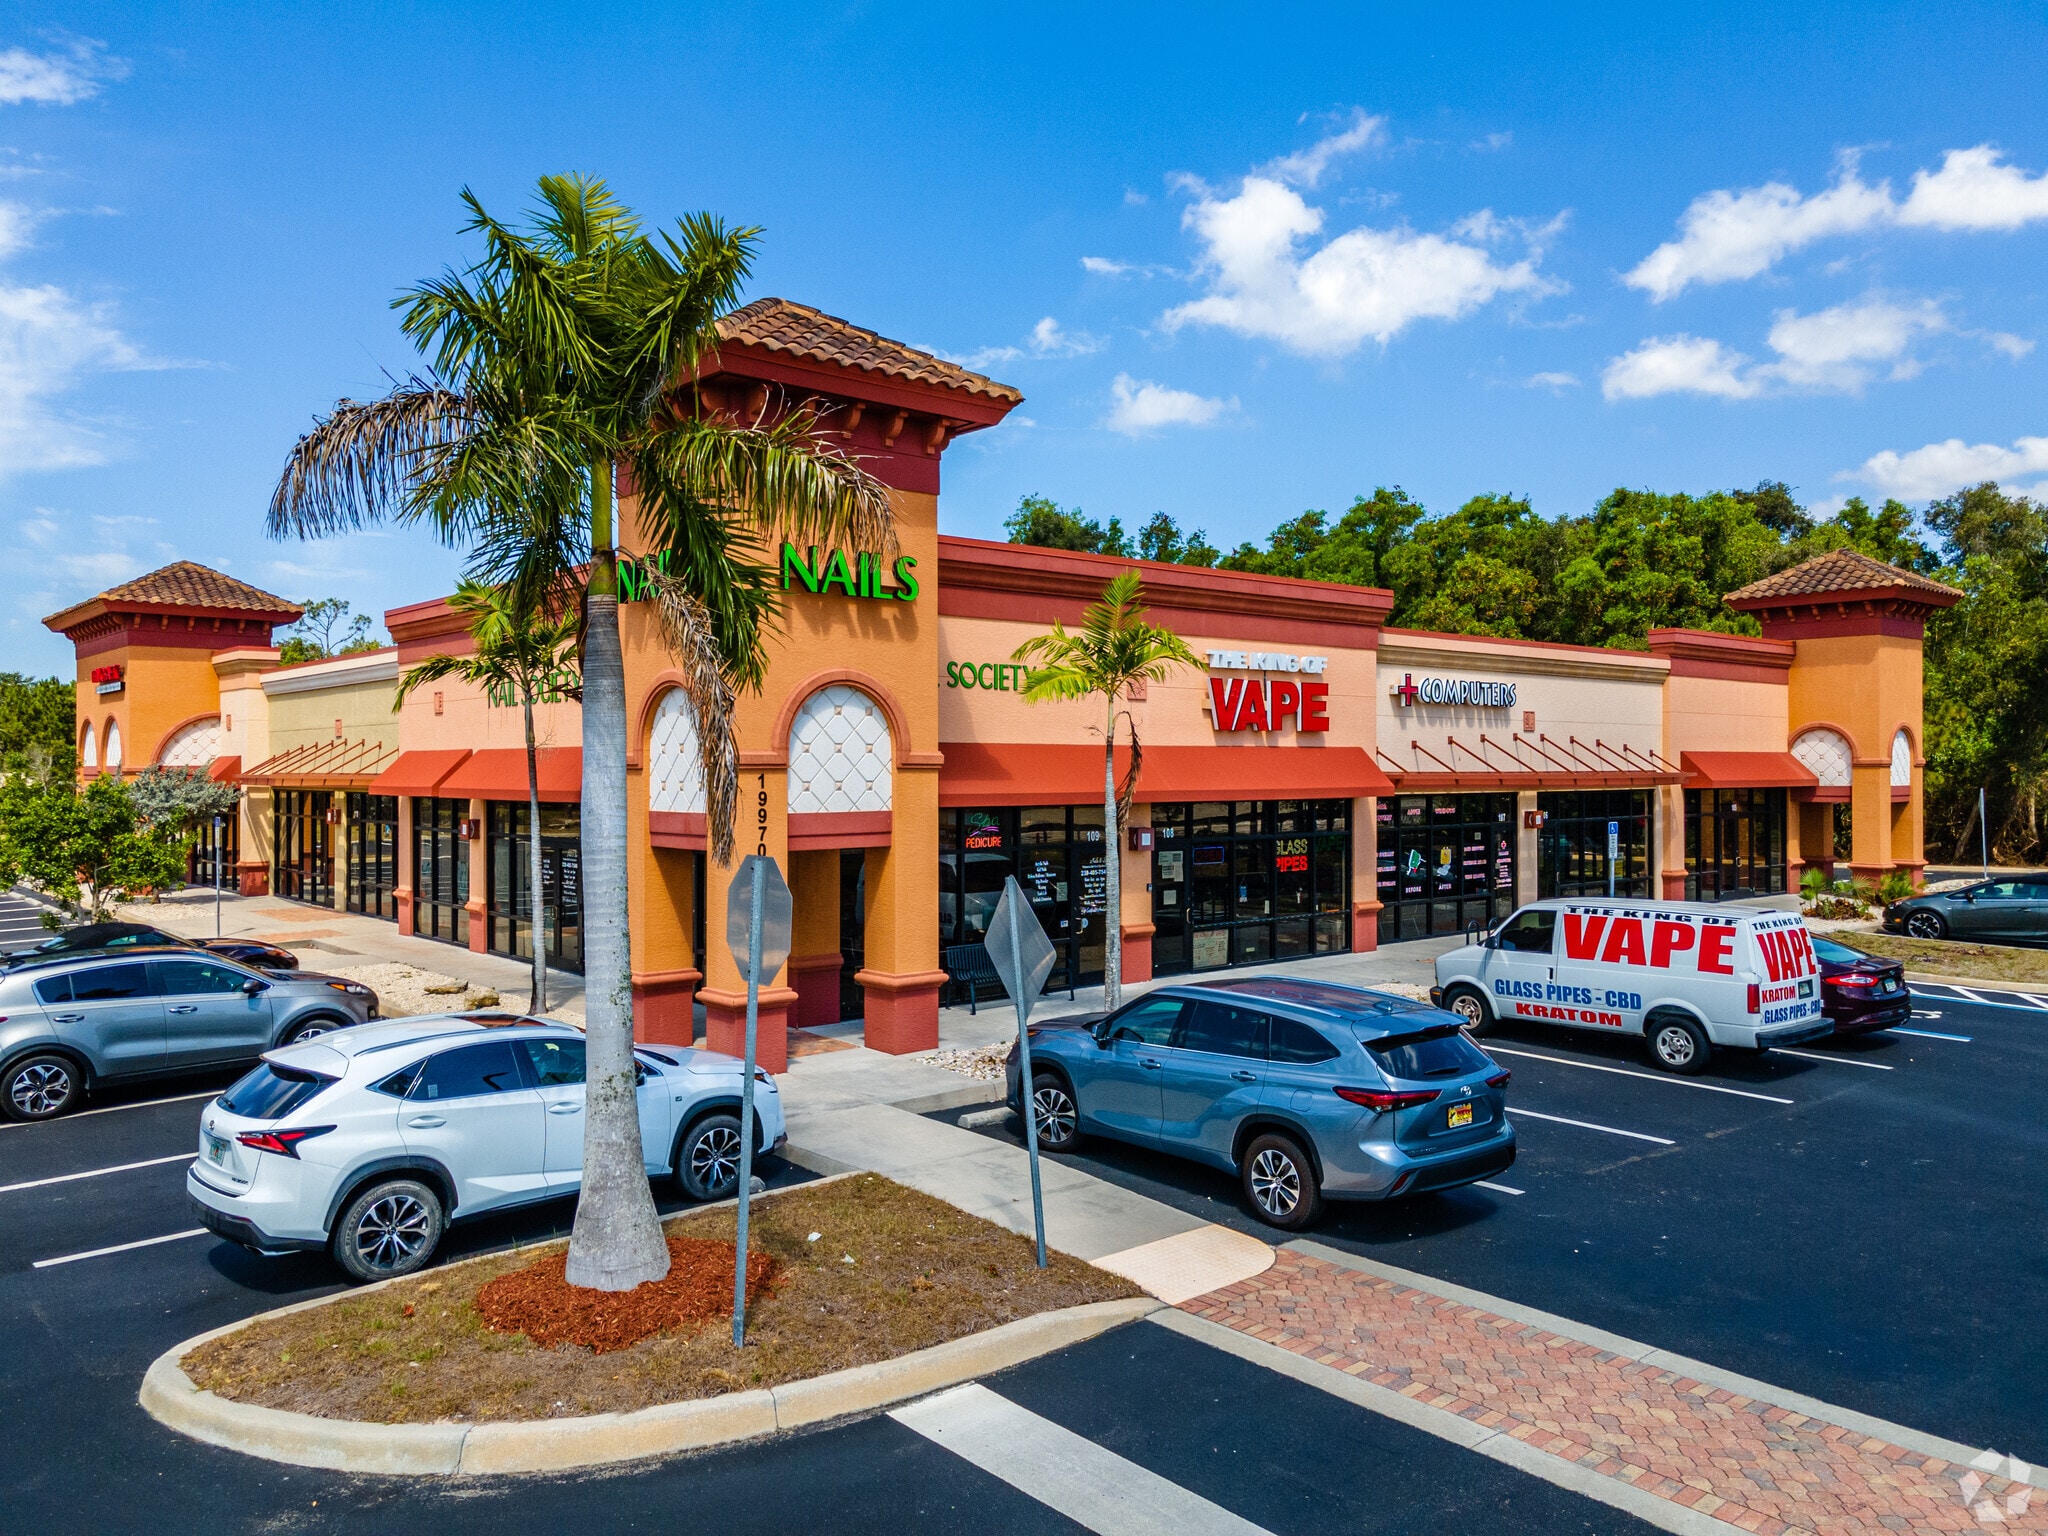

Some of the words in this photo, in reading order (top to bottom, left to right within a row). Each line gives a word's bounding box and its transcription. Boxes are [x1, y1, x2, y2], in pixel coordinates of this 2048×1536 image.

[780, 542, 919, 602] NAILS
[1206, 649, 1248, 669] THE
[1249, 652, 1299, 672] KING
[1300, 656, 1329, 674] OF
[488, 679, 518, 708] NAIL
[521, 671, 582, 706] OCIET
[1420, 678, 1517, 708] COMPUTERS
[1208, 678, 1330, 732] VAPE
[757, 773, 768, 856] 19970
[966, 836, 1002, 849] PEDICURE
[1087, 831, 1100, 842] 109
[1405, 886, 1422, 894] BEFORE
[1569, 907, 1614, 917] THE
[1623, 910, 1695, 922] KING
[1702, 917, 1742, 926] OF
[1752, 921, 1771, 931] THE
[1772, 918, 1793, 928] KING
[1794, 917, 1804, 925] OF
[1563, 913, 1737, 975] VAPE
[1755, 927, 1817, 983] VAPE
[1494, 978, 1542, 999] GLASS
[1546, 983, 1592, 1005] PIPES
[1605, 990, 1642, 1010] CBD
[1762, 985, 1796, 1004] KRATOM
[1515, 1002, 1622, 1026] KRATOM
[1764, 1008, 1788, 1024] GLASS
[1789, 1003, 1807, 1020] PIPES
